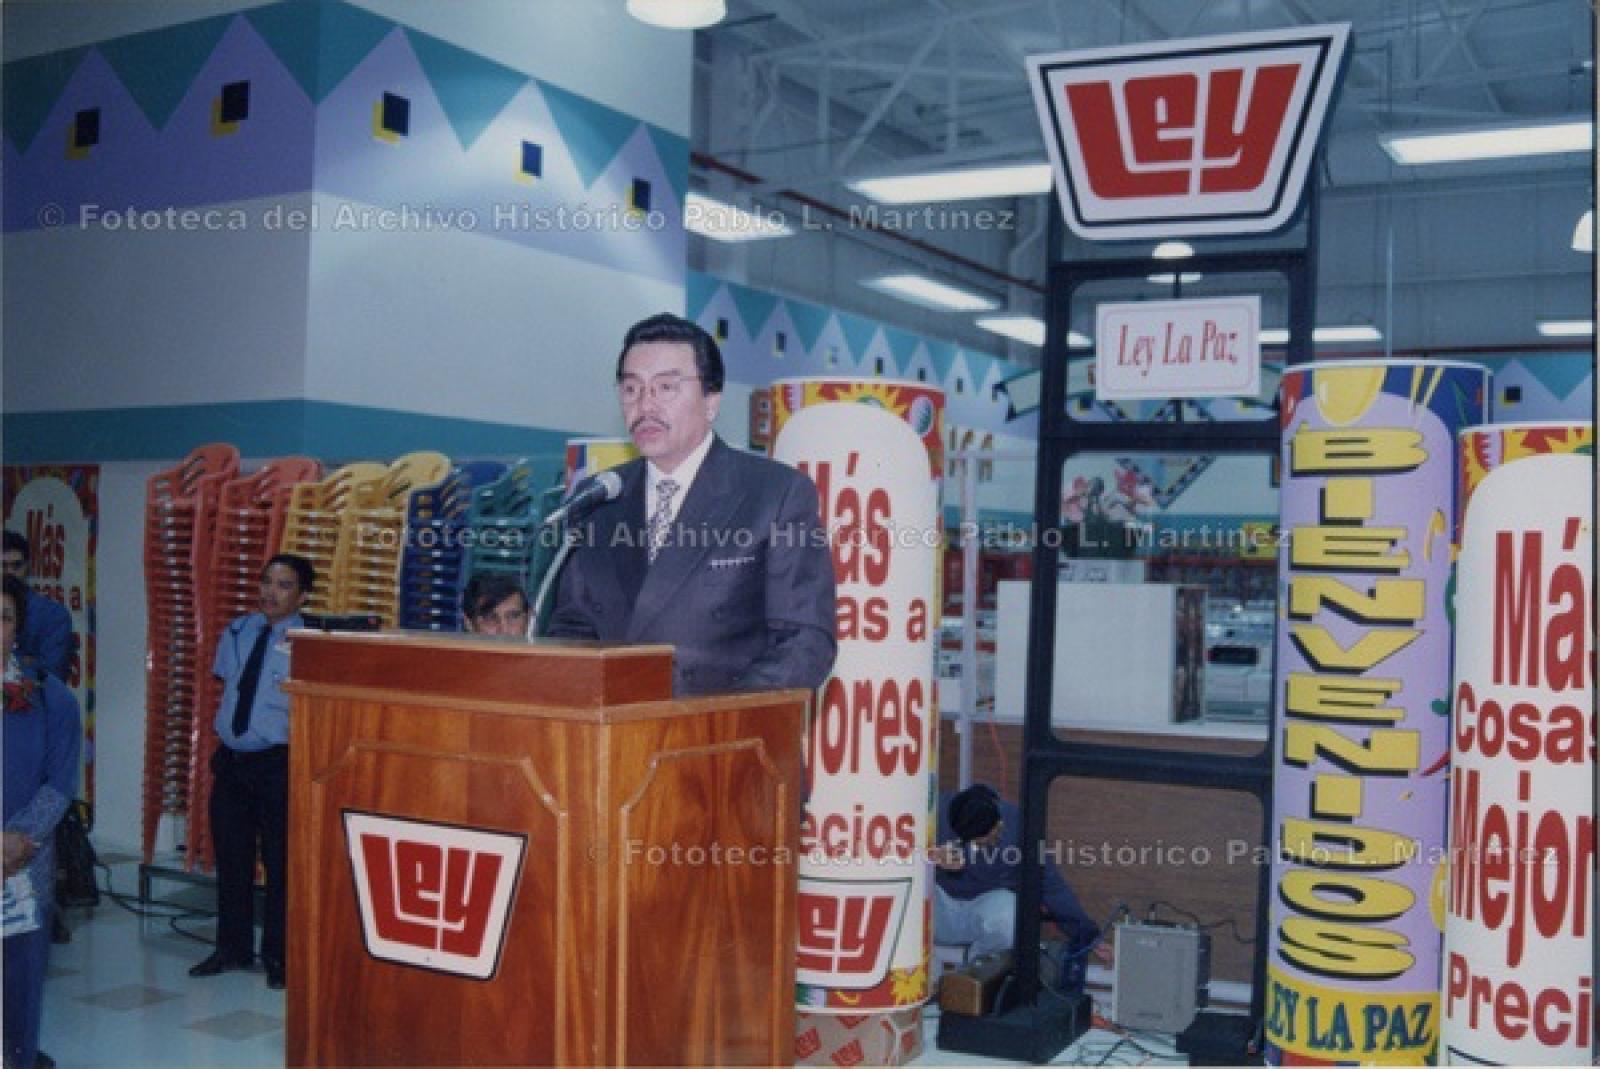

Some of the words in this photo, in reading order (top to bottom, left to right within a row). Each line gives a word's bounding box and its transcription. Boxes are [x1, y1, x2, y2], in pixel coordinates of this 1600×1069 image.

[1064, 64, 1302, 199] Ley
[1117, 324, 1155, 377] Ley
[1161, 322, 1192, 366] La
[1200, 319, 1238, 365] Paz
[906, 597, 926, 643] a
[1493, 516, 1593, 693] Má
[1278, 426, 1428, 981] BIENVENIDOS
[1455, 682, 1593, 764] Cosa
[360, 832, 504, 958] Ley
[1306, 996, 1354, 1053] LA
[1362, 1002, 1432, 1053] PAZ
